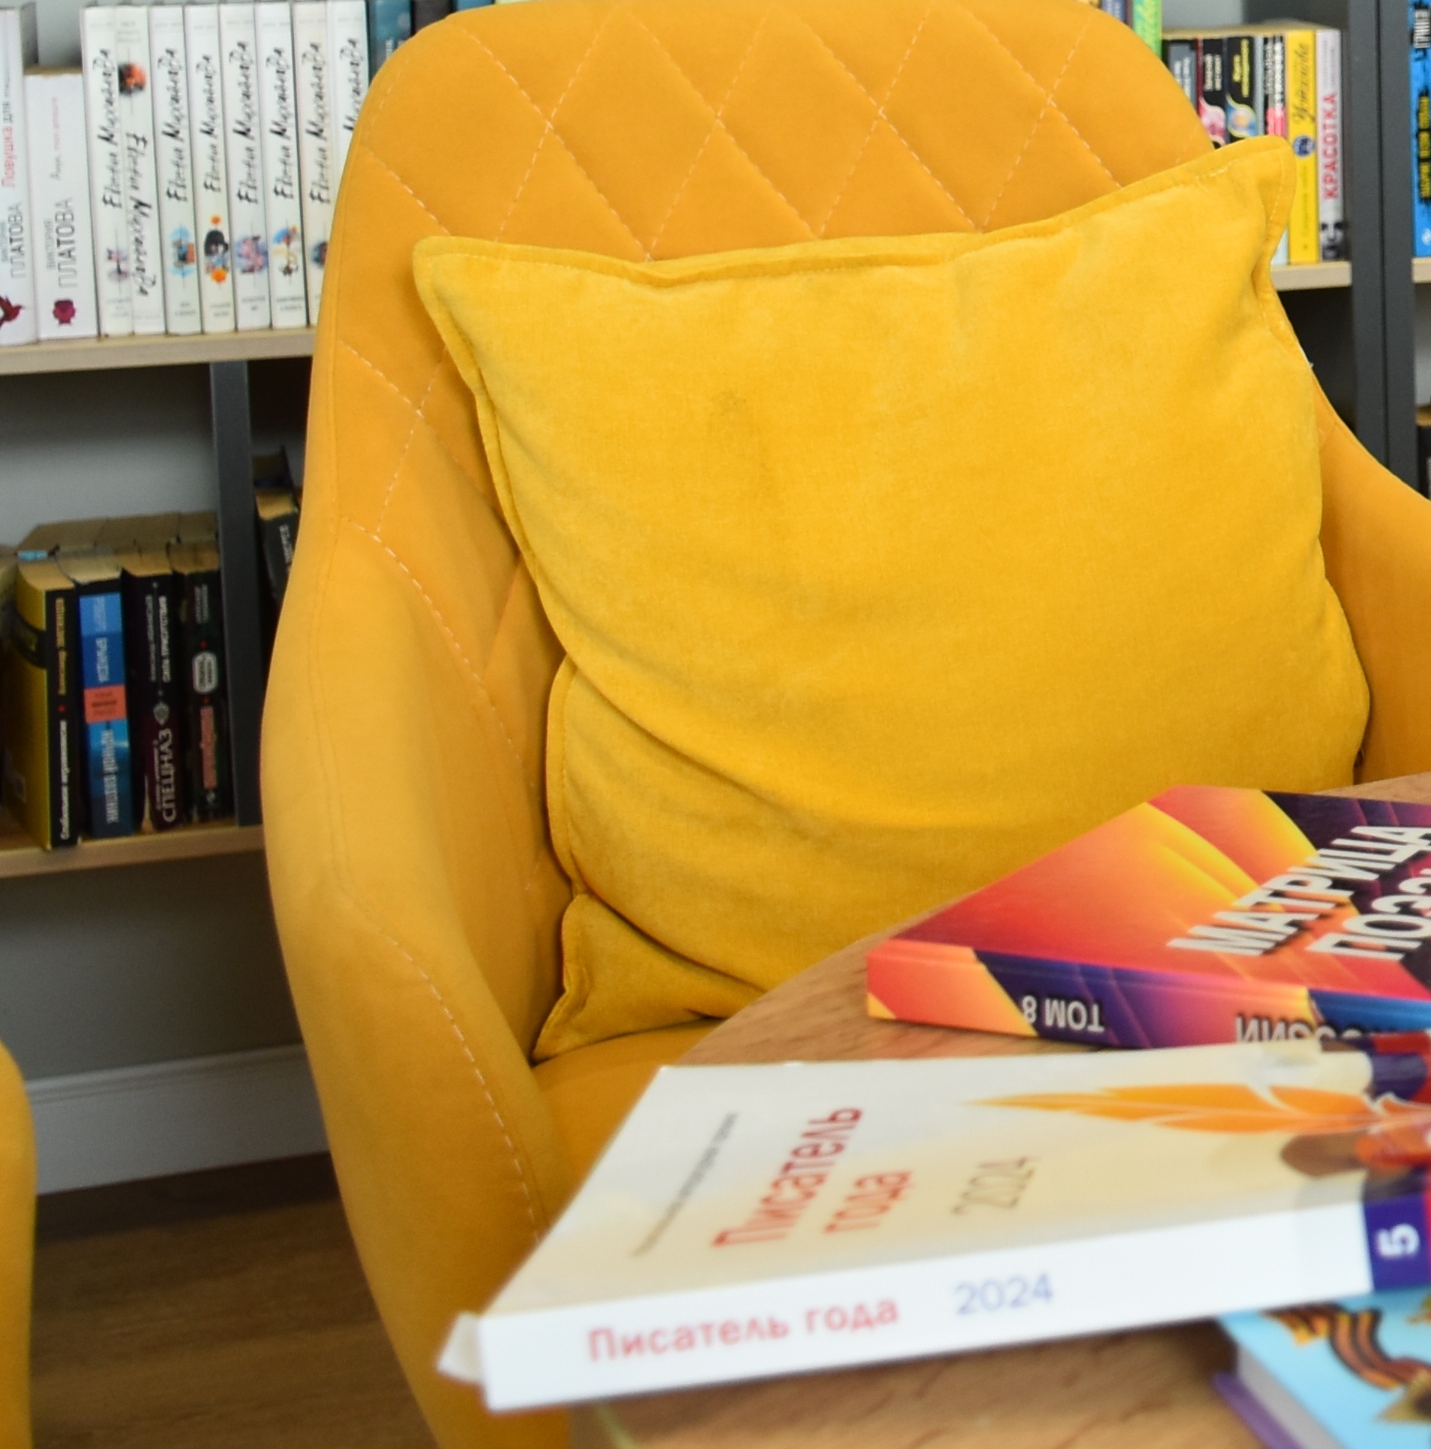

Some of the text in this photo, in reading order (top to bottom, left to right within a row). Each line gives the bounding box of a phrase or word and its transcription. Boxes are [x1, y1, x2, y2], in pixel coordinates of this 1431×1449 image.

[1322, 93, 1338, 199] КРАСОТКА
[7, 203, 25, 278] ПЛАТОВА
[55, 198, 77, 287] ПЛАТОВА
[155, 729, 176, 823] СПЕЦНАЗ
[1021, 994, 1105, 1033] ТОМ 8
[711, 1106, 864, 1249] Писатель
[824, 1170, 913, 1236] года
[952, 1156, 1040, 1219] 2024
[1376, 1227, 1421, 1259] 5
[586, 1272, 1056, 1363] Писатель года 2024
